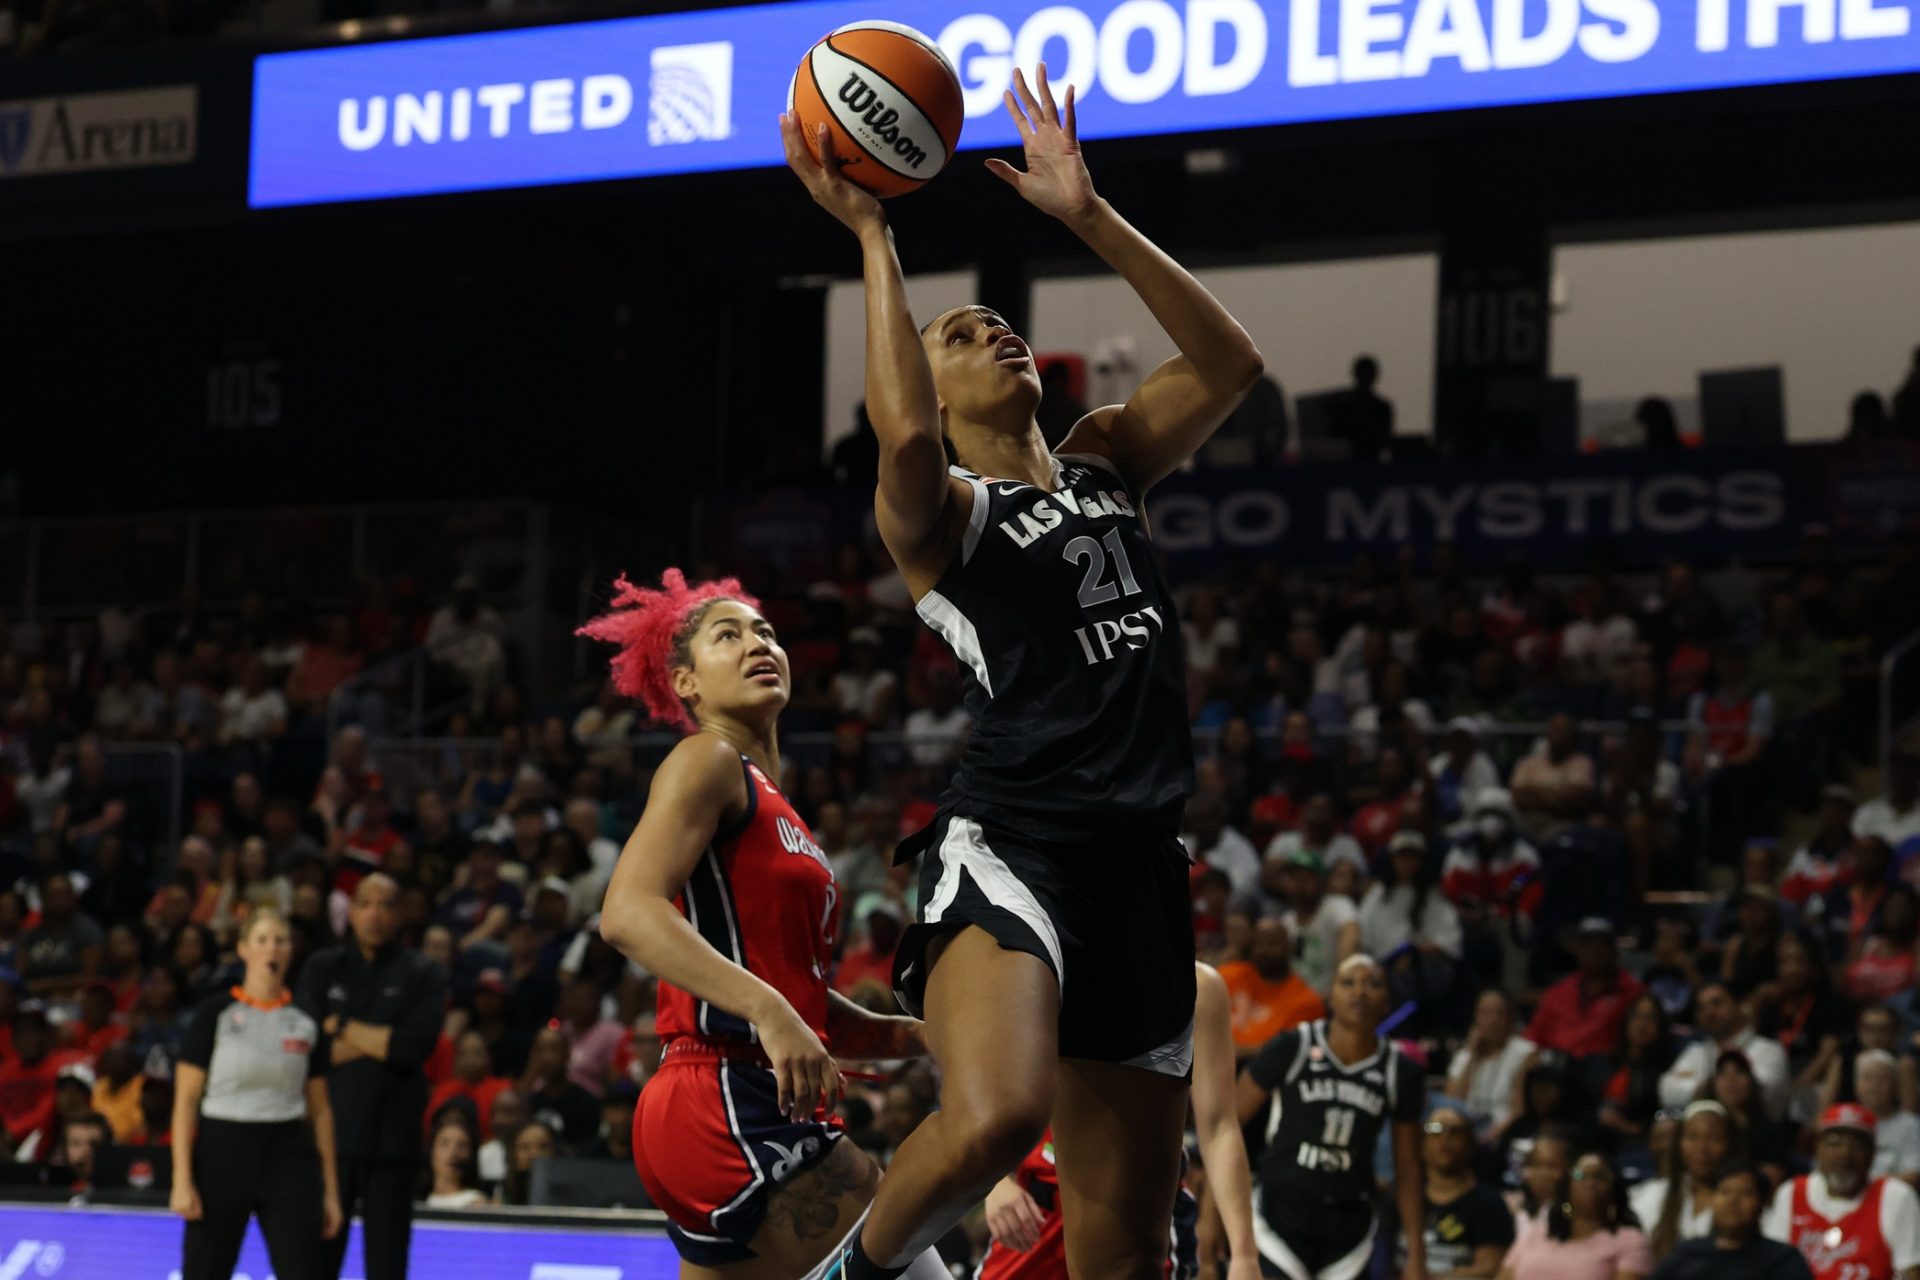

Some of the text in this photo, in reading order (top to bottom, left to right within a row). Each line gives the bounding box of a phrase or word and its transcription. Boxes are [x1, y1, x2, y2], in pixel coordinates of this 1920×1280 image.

[935, 0, 1268, 119] GOOD
[1287, 0, 1661, 87] LEADS
[36, 103, 190, 164] Arena
[338, 73, 634, 151] UNITED
[839, 71, 927, 169] Wilson
[1441, 288, 1539, 367] 106
[205, 361, 284, 429] 105
[999, 489, 1136, 549] LAS VGAS
[1149, 489, 1292, 549] GO
[1325, 469, 1787, 542] MYSTICS
[1062, 526, 1143, 608] 21
[1321, 1106, 1357, 1146] 11
